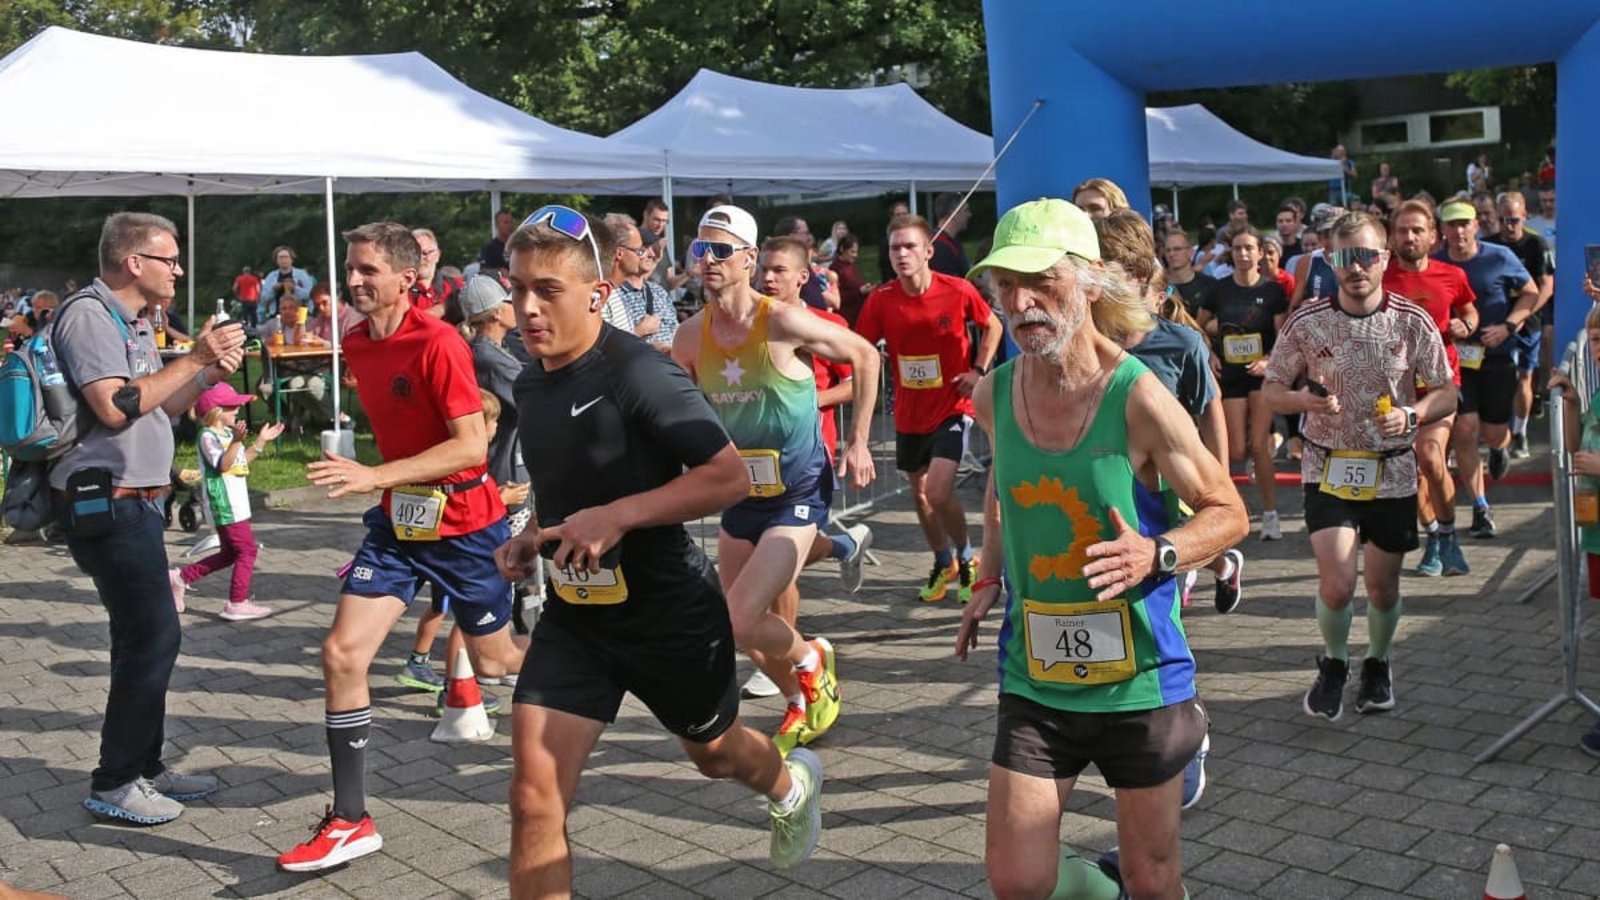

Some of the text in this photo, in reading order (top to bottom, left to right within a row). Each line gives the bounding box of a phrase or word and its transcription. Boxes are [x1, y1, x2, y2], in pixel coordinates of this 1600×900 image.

[908, 365, 927, 379] 26
[1343, 465, 1366, 484] 55
[395, 502, 426, 525] 402
[1055, 618, 1085, 628] Rainer
[1055, 629, 1093, 658] 48
